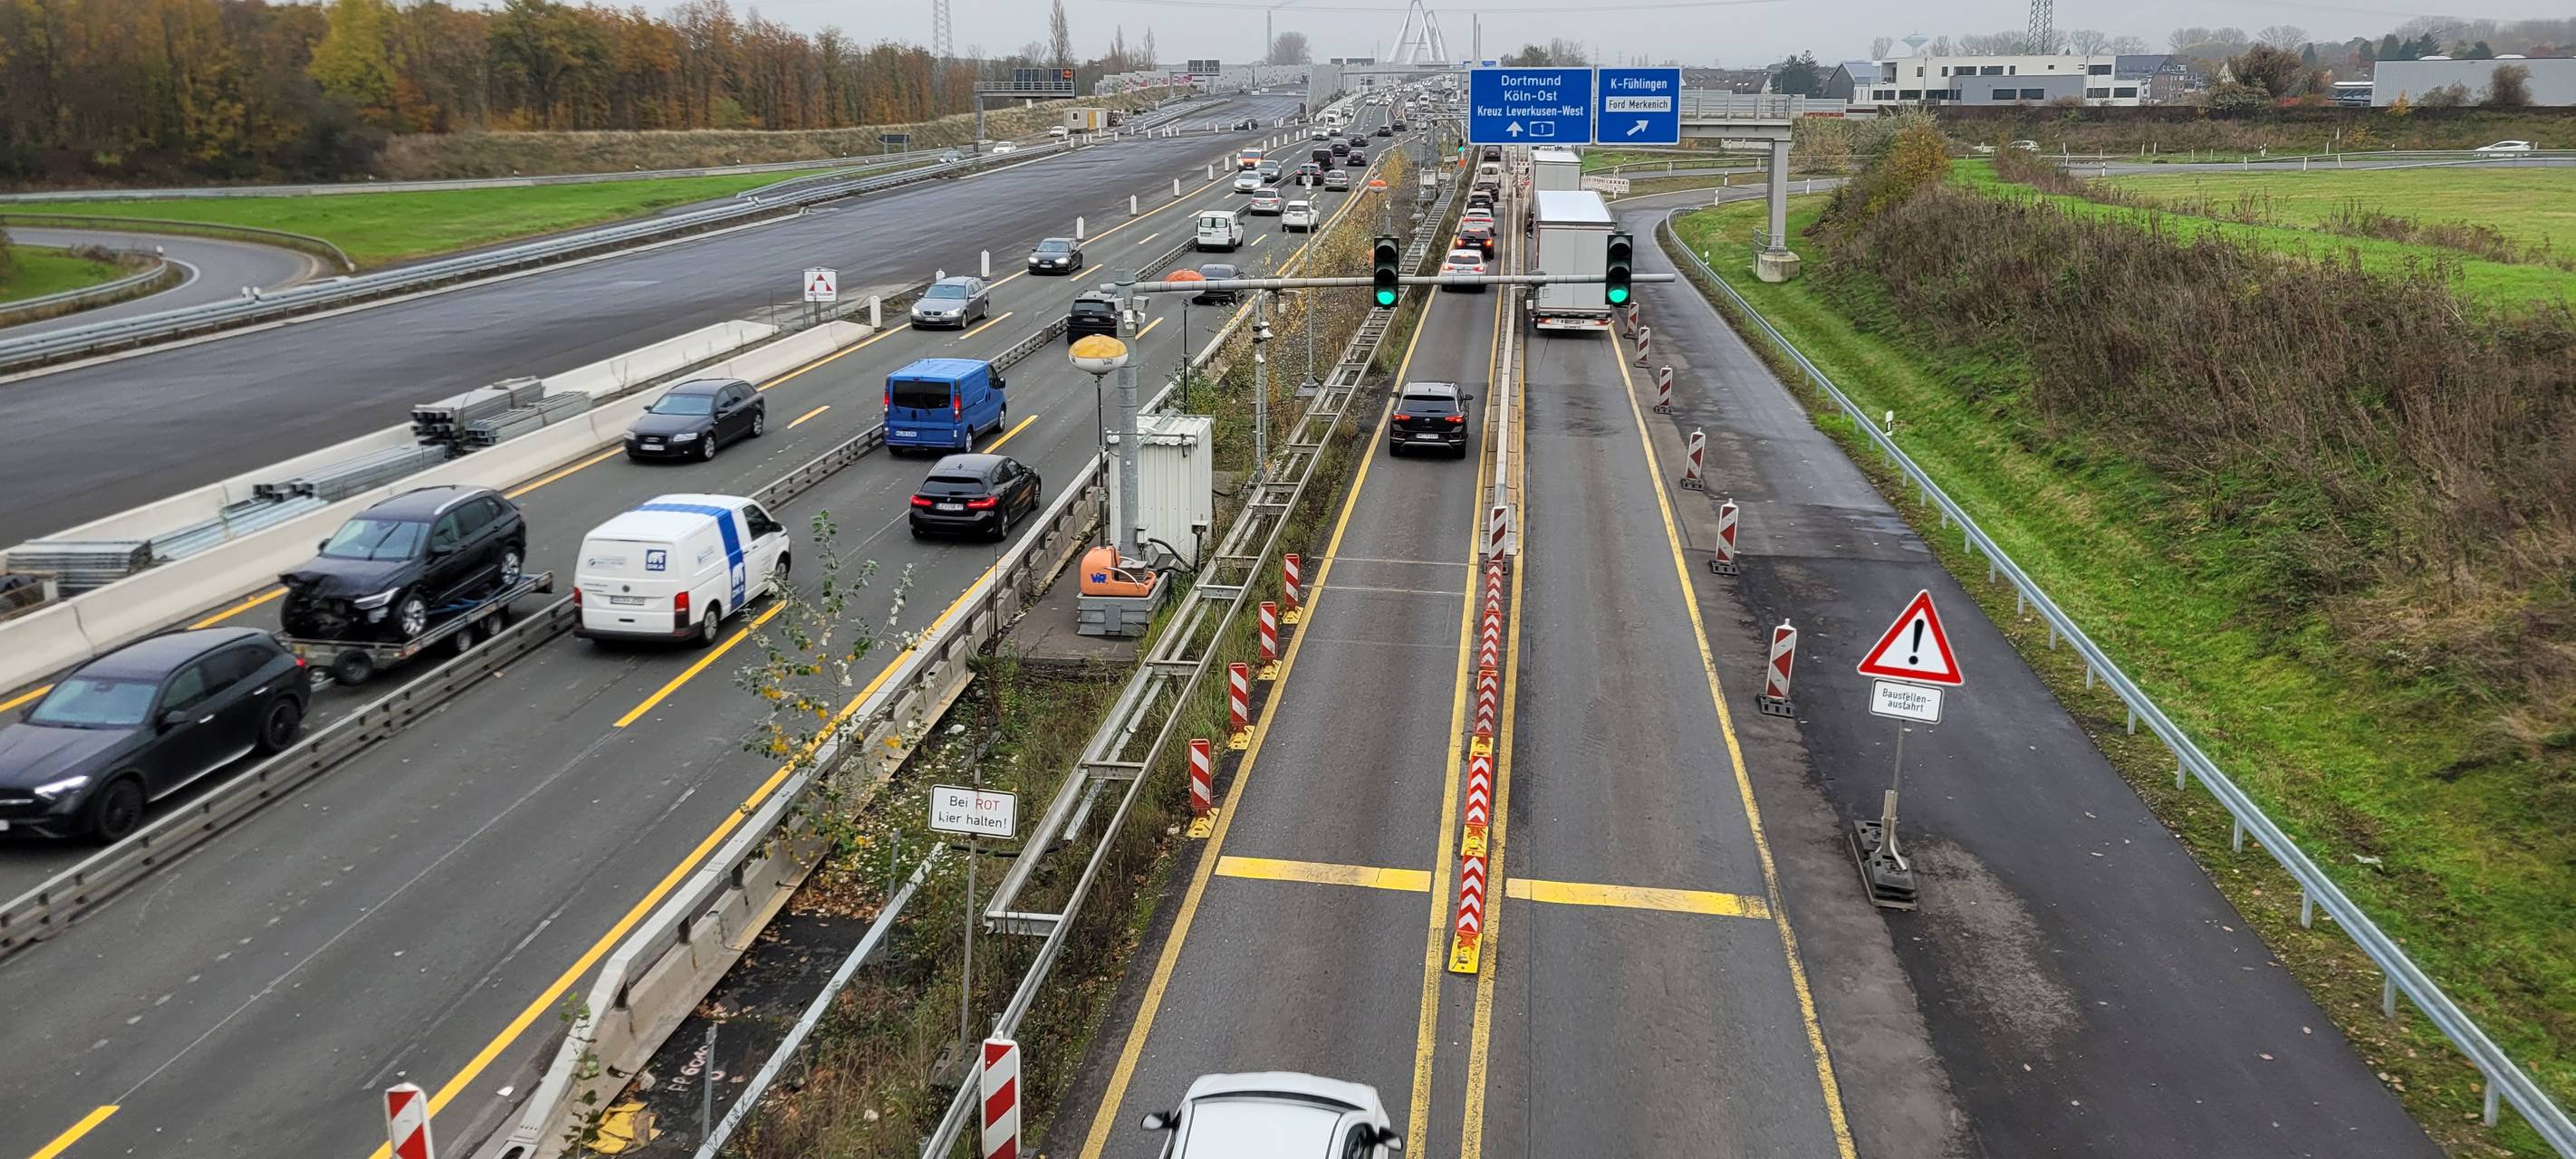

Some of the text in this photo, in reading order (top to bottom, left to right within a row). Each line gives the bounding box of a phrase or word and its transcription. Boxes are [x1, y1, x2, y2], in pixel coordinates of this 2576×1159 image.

[1501, 75, 1562, 87] Dortmund
[1610, 78, 1668, 91] K-Fühlingen
[1504, 90, 1558, 101] Köln-Ost
[1609, 100, 1668, 109] Ford Merkenich
[1477, 106, 1584, 117] Kreuz Leverkusen-West
[1540, 124, 1544, 134] 1
[1882, 688, 1932, 704] Baustellen-
[1888, 700, 1924, 713] ausfahrt
[949, 796, 1001, 811] Bei ROT
[966, 814, 1007, 829] halten!
